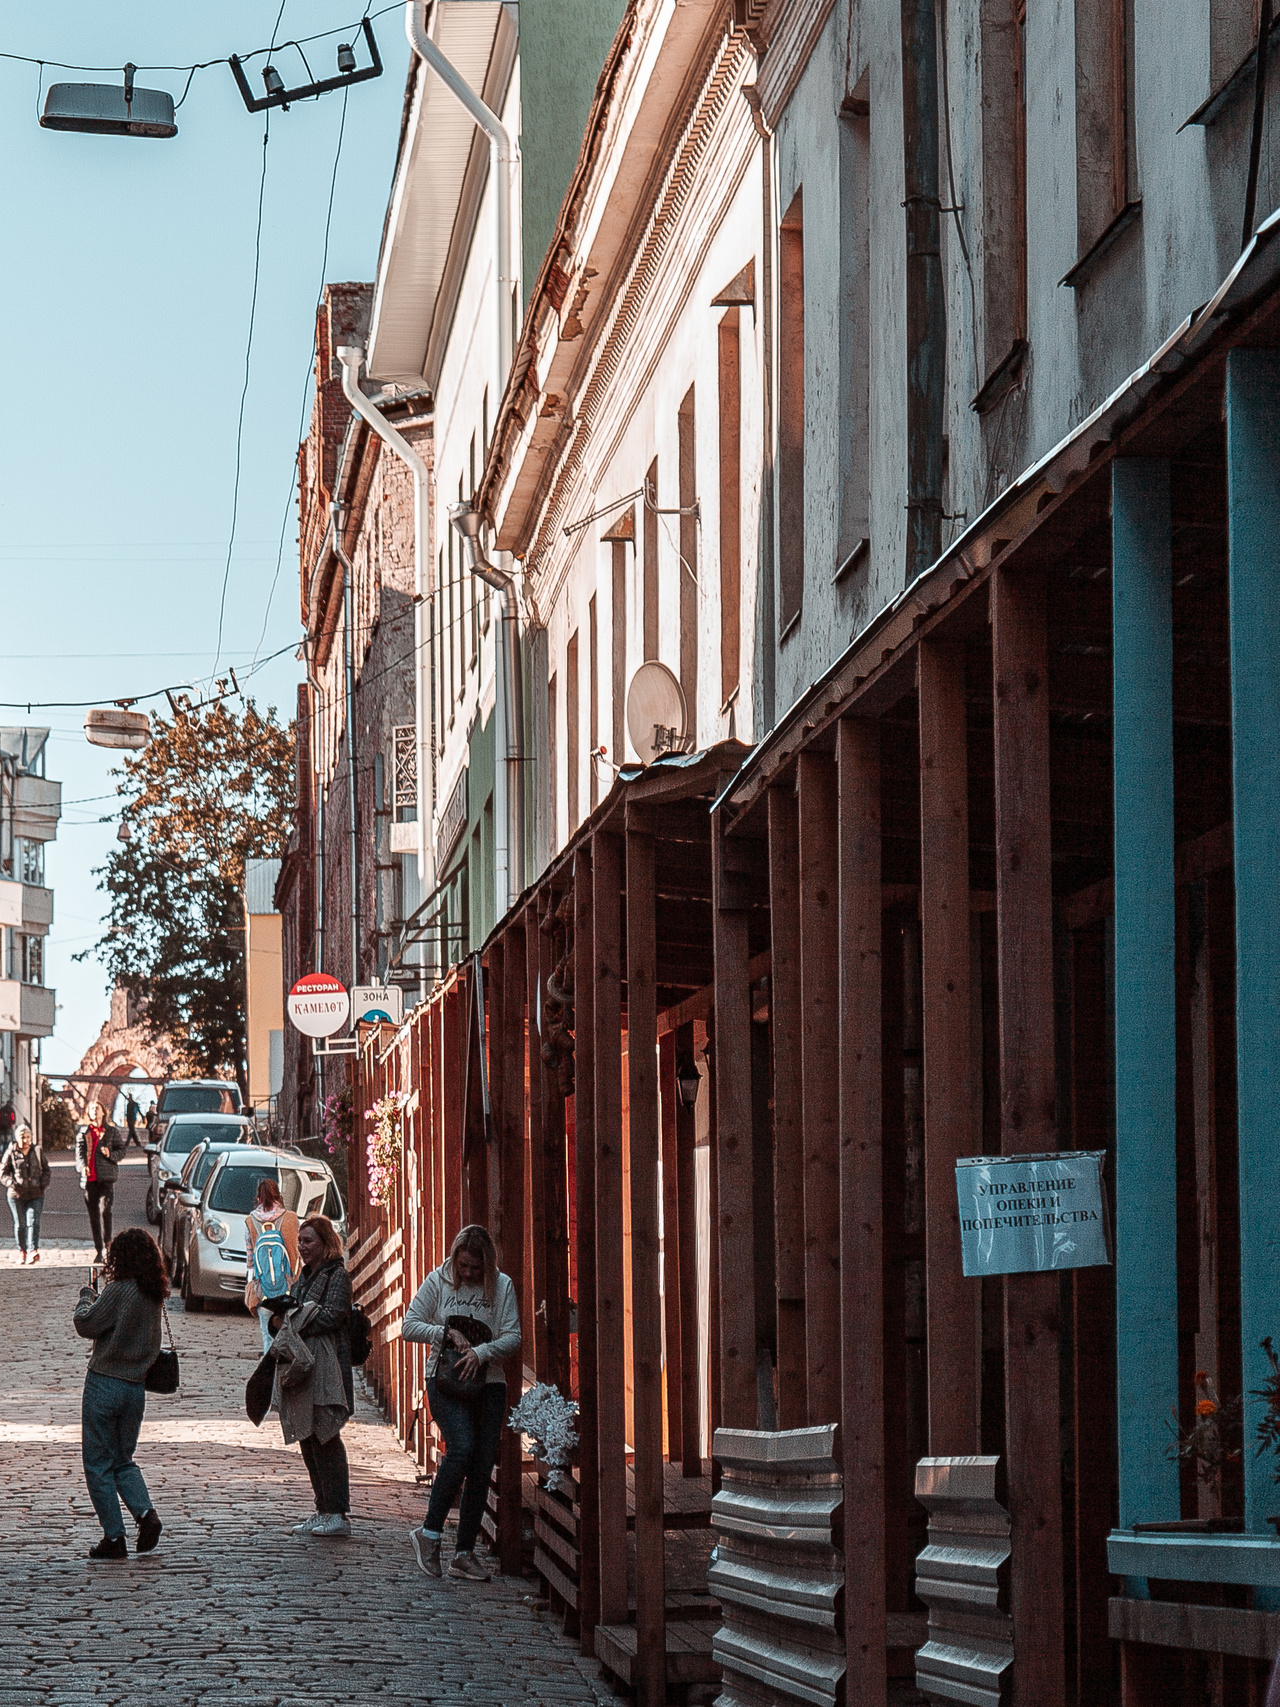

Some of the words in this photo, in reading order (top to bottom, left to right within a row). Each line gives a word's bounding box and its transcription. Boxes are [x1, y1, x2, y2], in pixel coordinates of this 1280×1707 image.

[296, 983, 339, 993] РЕСТОРАН
[362, 992, 390, 1002] ЗОНА
[294, 1001, 344, 1015] КАМЕЛОТ
[978, 1178, 1076, 1197] УПРАВЛЕНИЕ
[996, 1197, 1046, 1212] ОПЕКИ
[1050, 1196, 1061, 1208] И
[962, 1210, 1099, 1232] ПОПЕЧИТЕЛЬСТВА
